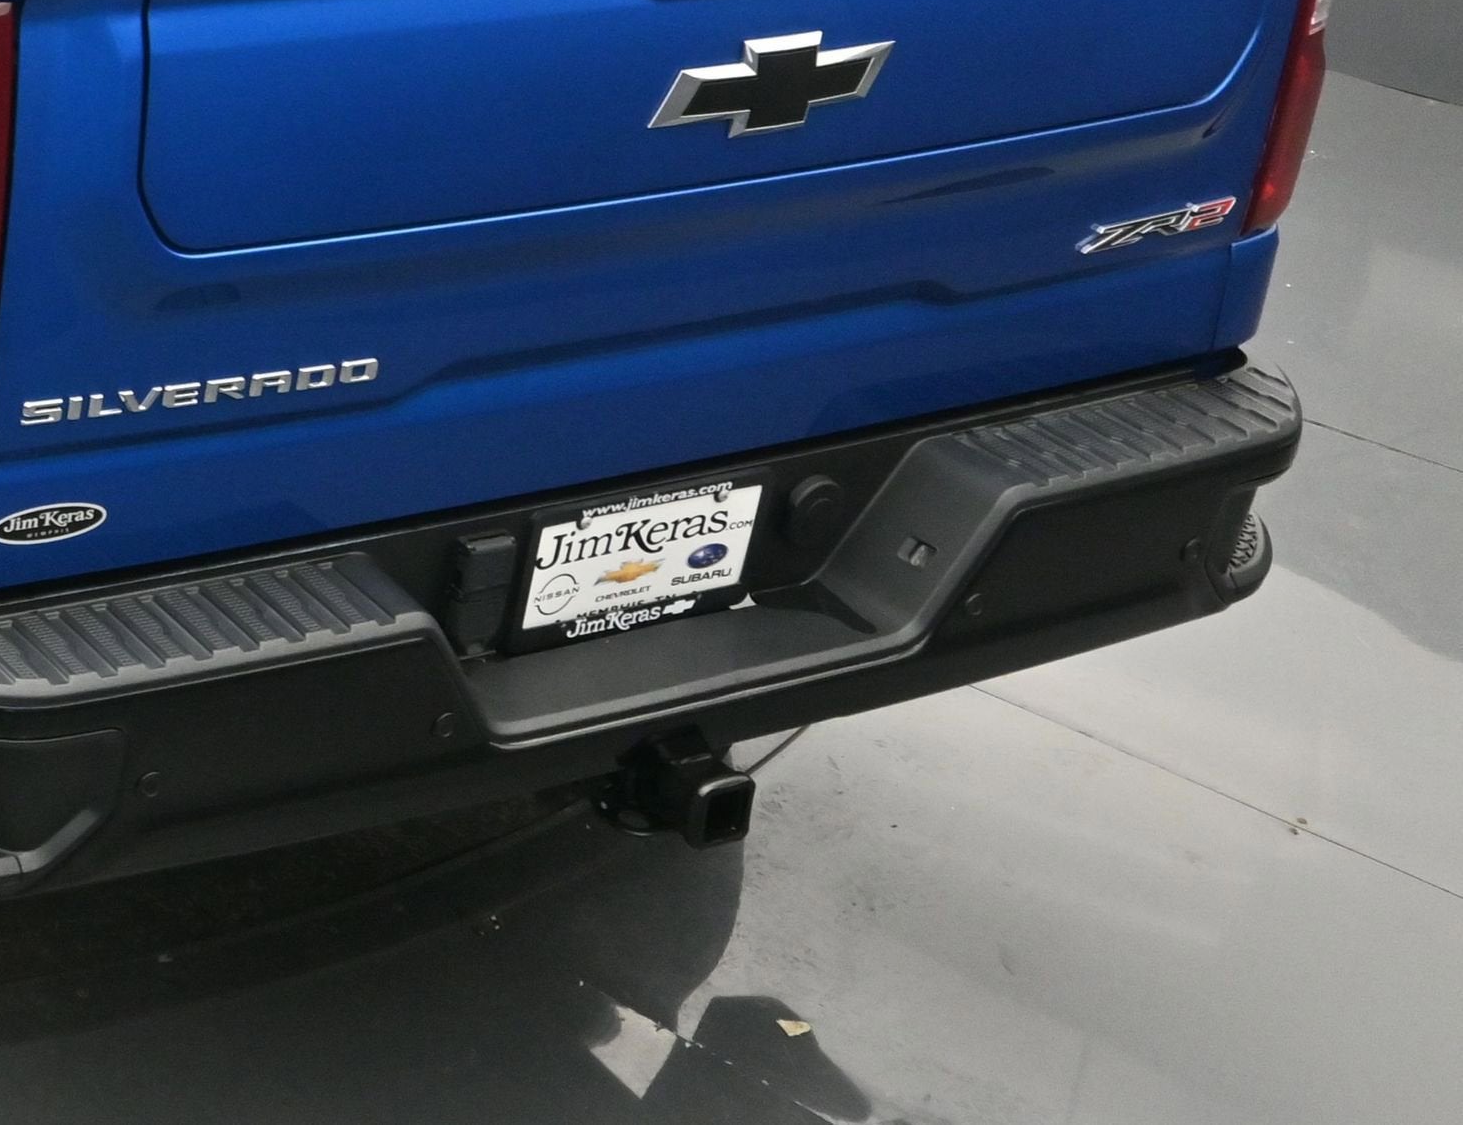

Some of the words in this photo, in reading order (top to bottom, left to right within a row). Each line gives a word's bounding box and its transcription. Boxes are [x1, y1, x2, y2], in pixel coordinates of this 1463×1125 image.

[1074, 195, 1236, 254] ZR2
[20, 357, 379, 426] SILVERADO
[582, 481, 733, 518] www.jimkeras.com
[671, 567, 732, 587] SUBARU
[534, 586, 580, 603] NISSAN
[595, 585, 651, 603] CHEVROLET
